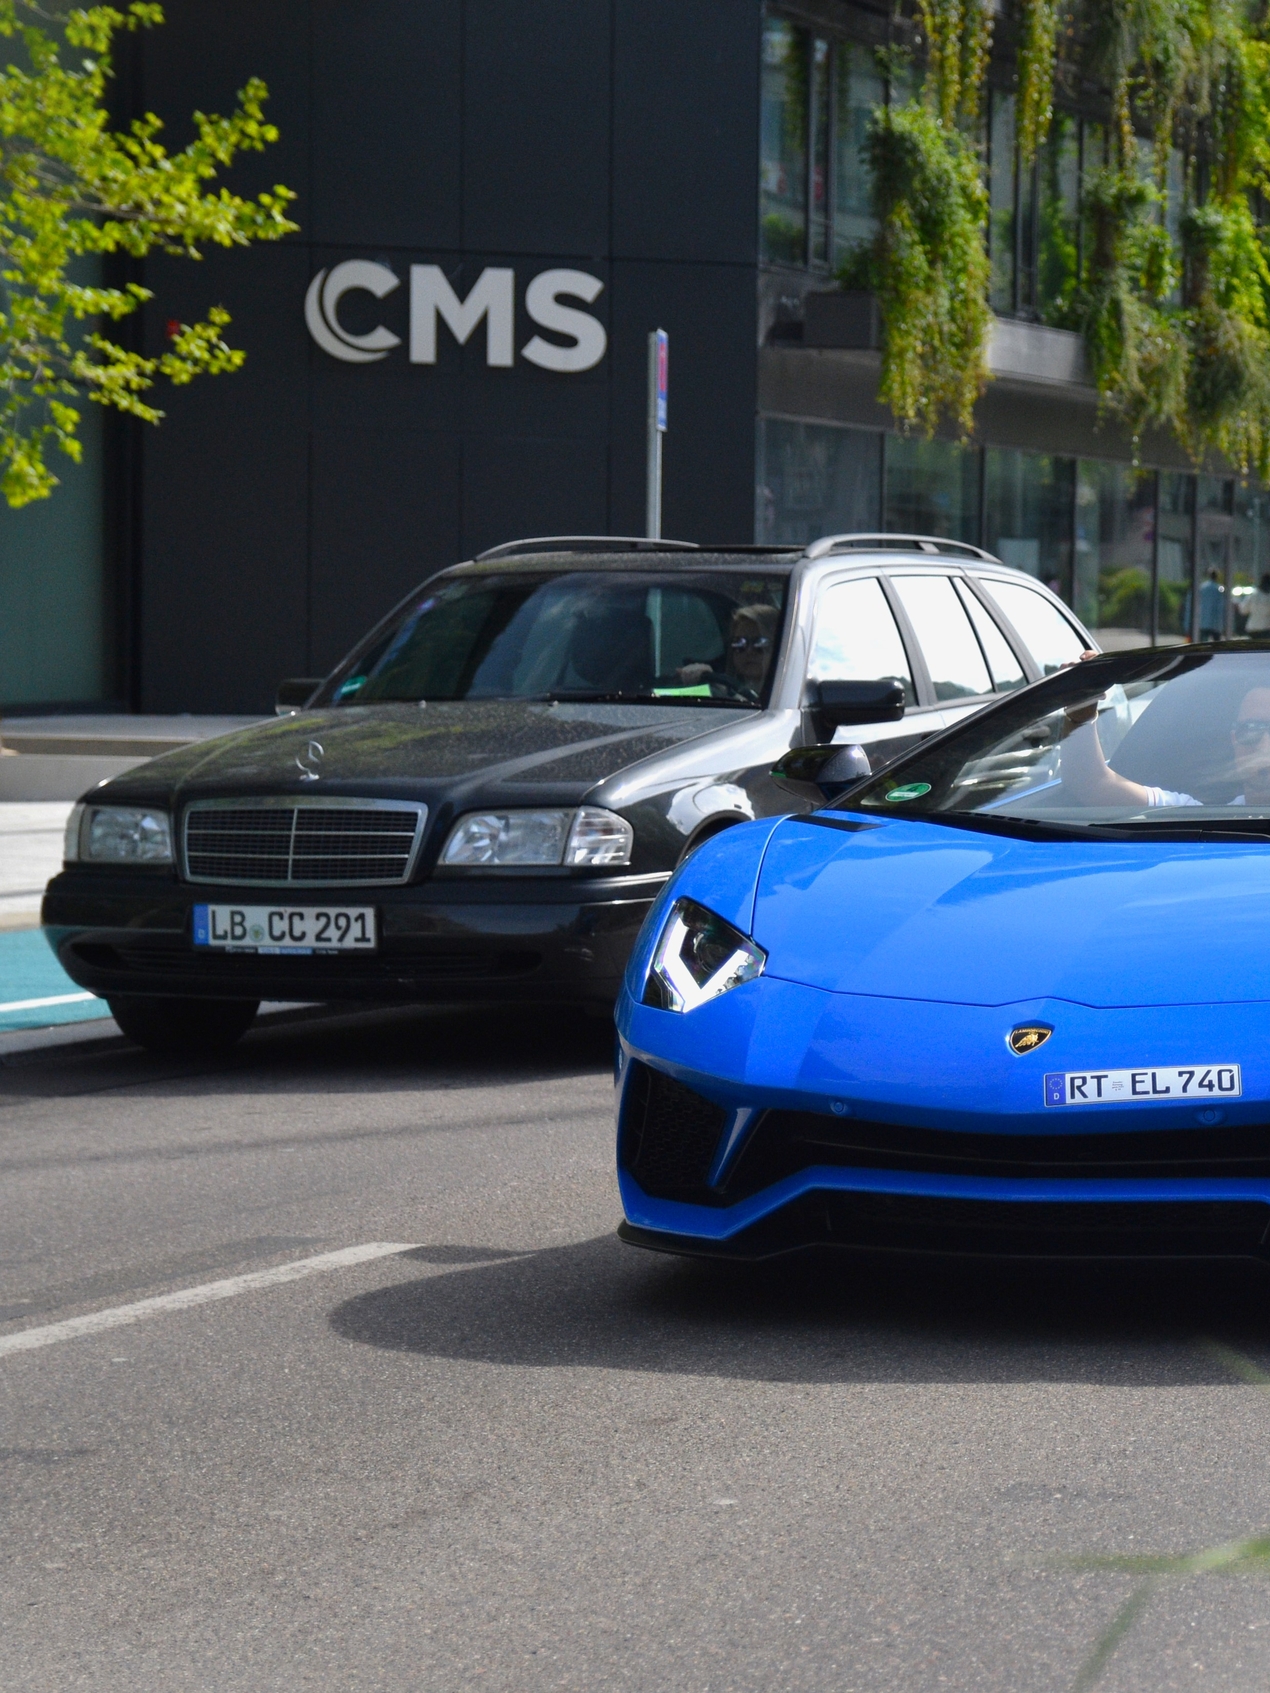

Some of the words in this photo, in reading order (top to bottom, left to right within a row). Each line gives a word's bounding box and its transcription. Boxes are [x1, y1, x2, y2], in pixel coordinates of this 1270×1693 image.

[305, 259, 607, 372] CMS
[211, 909, 247, 941] LB
[268, 911, 306, 942] CC
[315, 912, 371, 943] 291
[1053, 1092, 1060, 1100] D
[1069, 1075, 1108, 1099] RT
[1131, 1071, 1170, 1095] EL
[1178, 1069, 1234, 1093] 740
